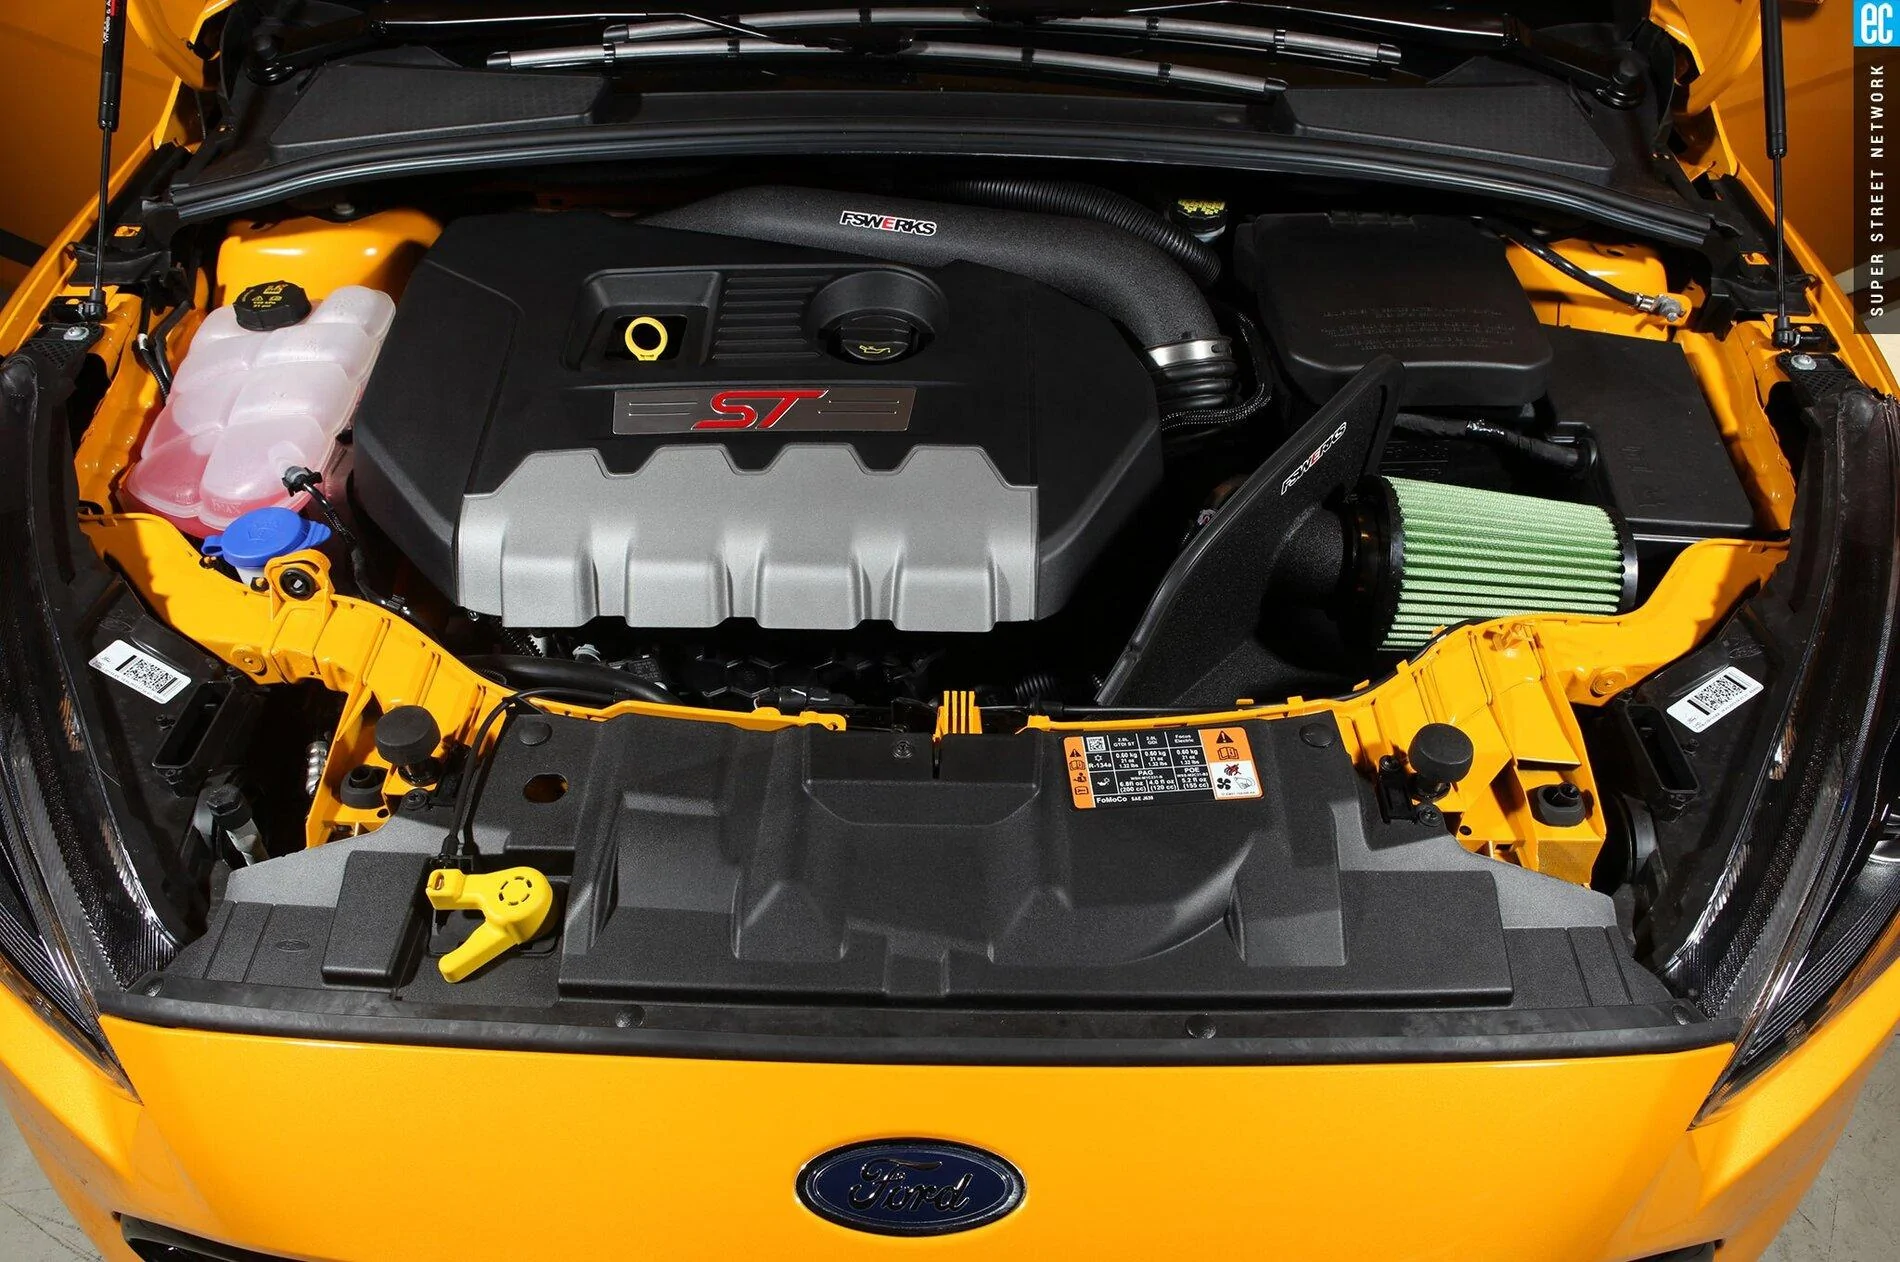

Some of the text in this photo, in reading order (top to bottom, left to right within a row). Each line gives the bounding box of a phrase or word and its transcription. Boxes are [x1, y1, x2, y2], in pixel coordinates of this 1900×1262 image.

[840, 211, 937, 236] FSWERKS
[691, 389, 829, 430] ST
[1281, 421, 1347, 495] FSWERKS
[849, 1157, 973, 1212] Ford
